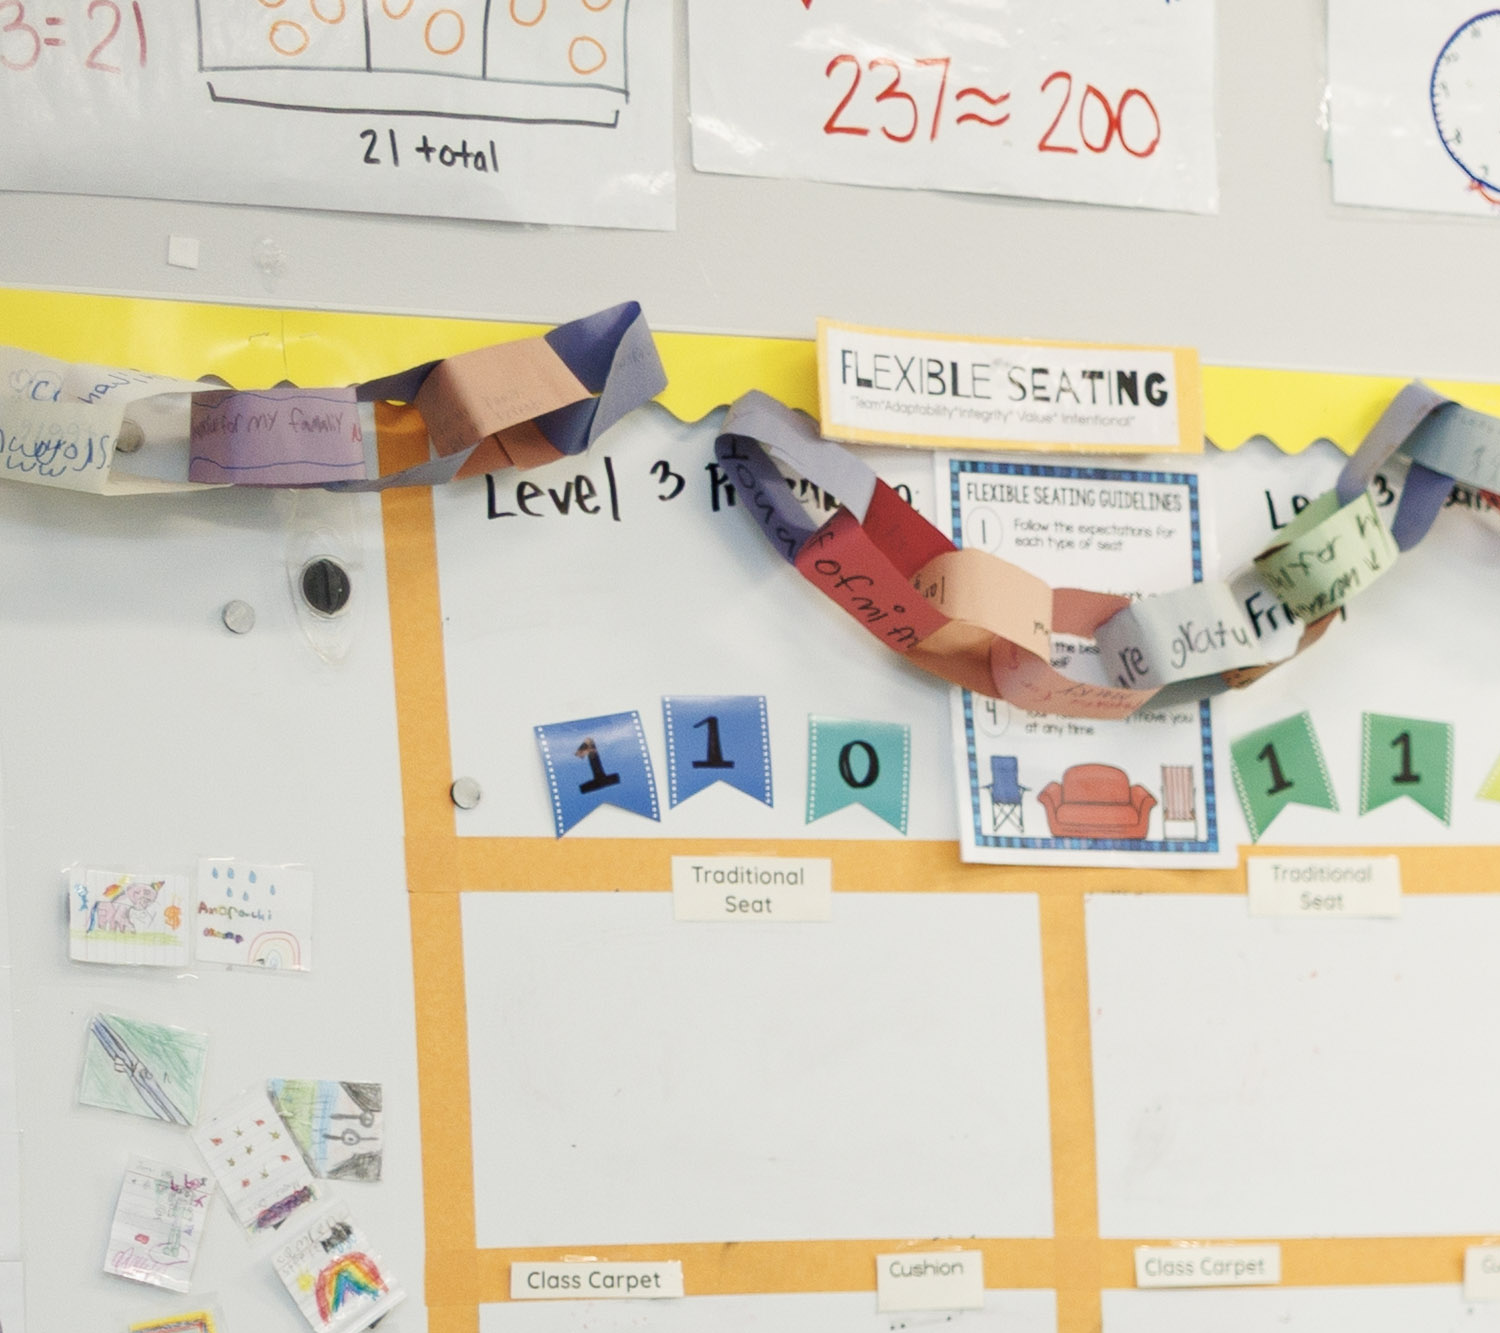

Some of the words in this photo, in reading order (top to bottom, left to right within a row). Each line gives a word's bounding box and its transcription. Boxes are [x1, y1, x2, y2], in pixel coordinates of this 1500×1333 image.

[1038, 71, 1161, 158] 200
[359, 129, 400, 167] 21
[415, 135, 500, 174] total
[841, 349, 994, 400] FLEXIBLE
[1007, 365, 1169, 408] SEATING
[484, 457, 623, 522] Level
[648, 459, 687, 503] 3
[967, 481, 1030, 505] FLEXIBLE
[1034, 485, 1096, 507] SEATING
[1100, 489, 1183, 513] GUIDELINES
[1013, 517, 1050, 533] Follow
[1055, 518, 1074, 534] the
[1155, 525, 1176, 539] for
[1015, 536, 1044, 548] each
[1049, 536, 1076, 551] type
[1098, 539, 1123, 552] seat
[691, 866, 805, 887] Traditional
[1270, 864, 1374, 885] Traditional
[724, 895, 773, 915] Seat
[1299, 891, 1345, 912] Seat
[888, 1258, 965, 1279] Cushion
[1143, 1258, 1195, 1277] Class
[1200, 1257, 1266, 1280] Carpet
[526, 1271, 582, 1290] Class
[587, 1270, 662, 1293] Carpet
